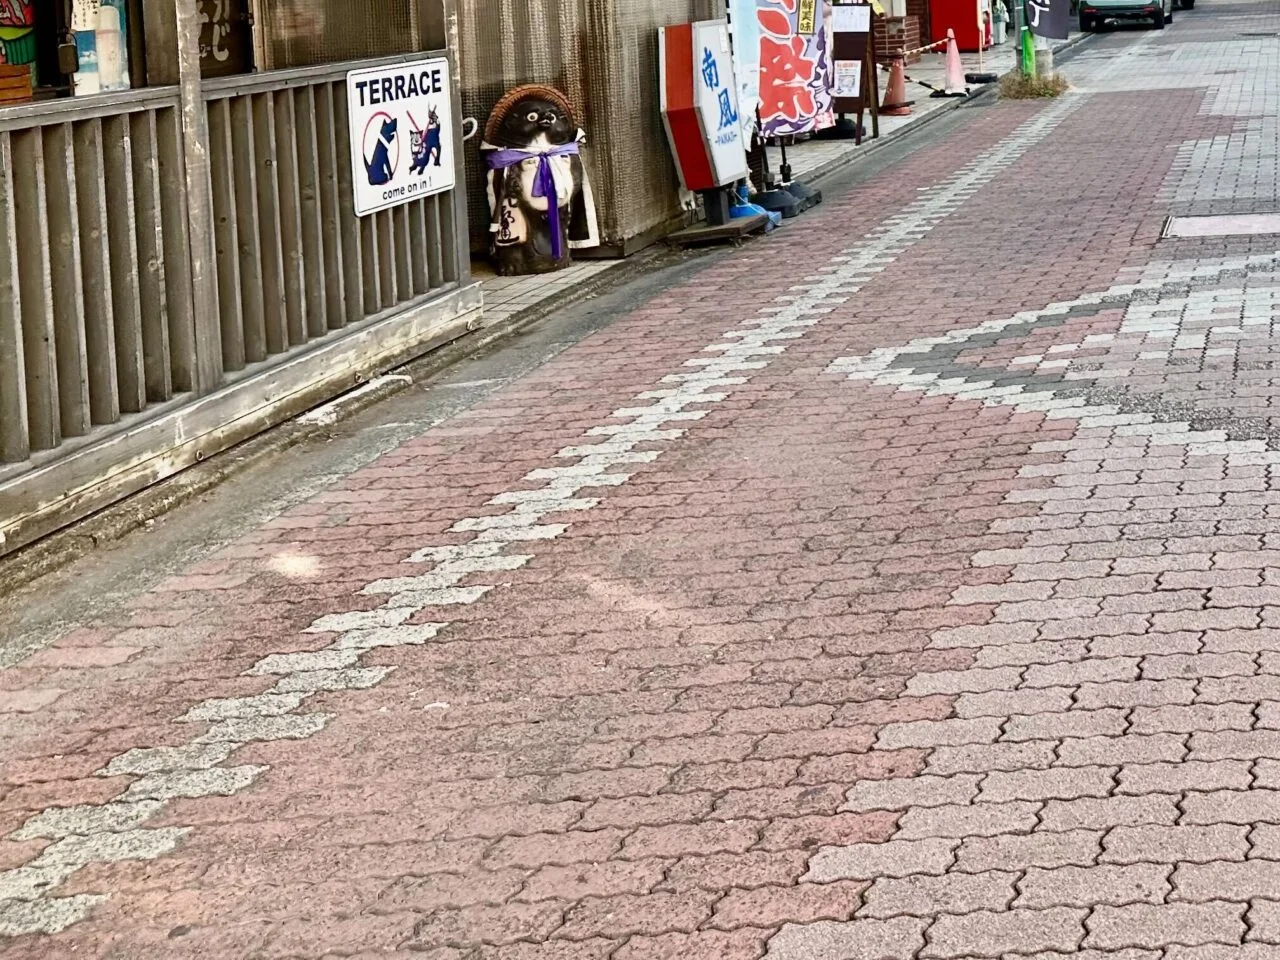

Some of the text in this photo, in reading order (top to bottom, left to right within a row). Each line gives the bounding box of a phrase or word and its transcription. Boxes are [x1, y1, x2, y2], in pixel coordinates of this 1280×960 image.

[355, 69, 442, 107] TERRACE
[701, 46, 738, 131] 南風
[382, 185, 406, 201] come
[407, 183, 418, 193] on
[420, 180, 428, 191] in
